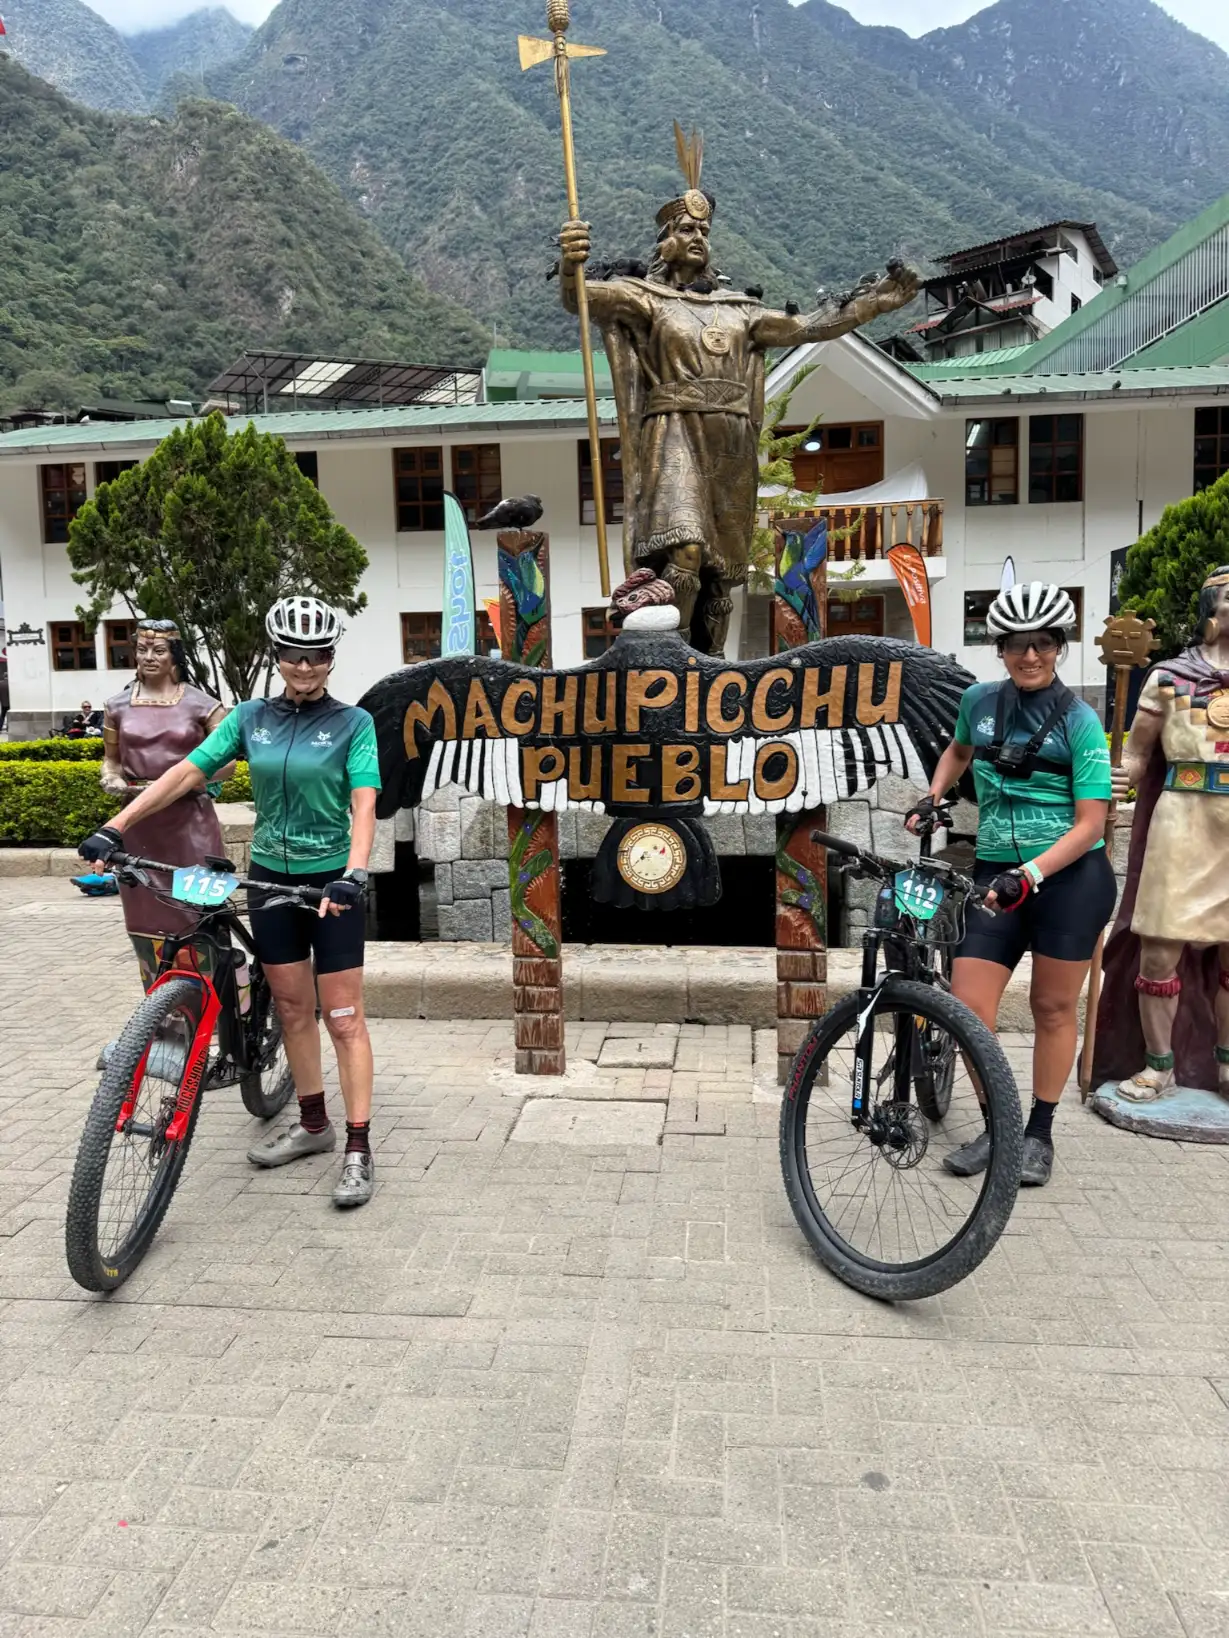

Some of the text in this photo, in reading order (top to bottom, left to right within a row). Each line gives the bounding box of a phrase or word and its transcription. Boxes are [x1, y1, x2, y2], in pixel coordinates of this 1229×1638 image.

[522, 741, 798, 802] PUEBLO
[182, 874, 227, 897] 115
[903, 879, 937, 910] 112
